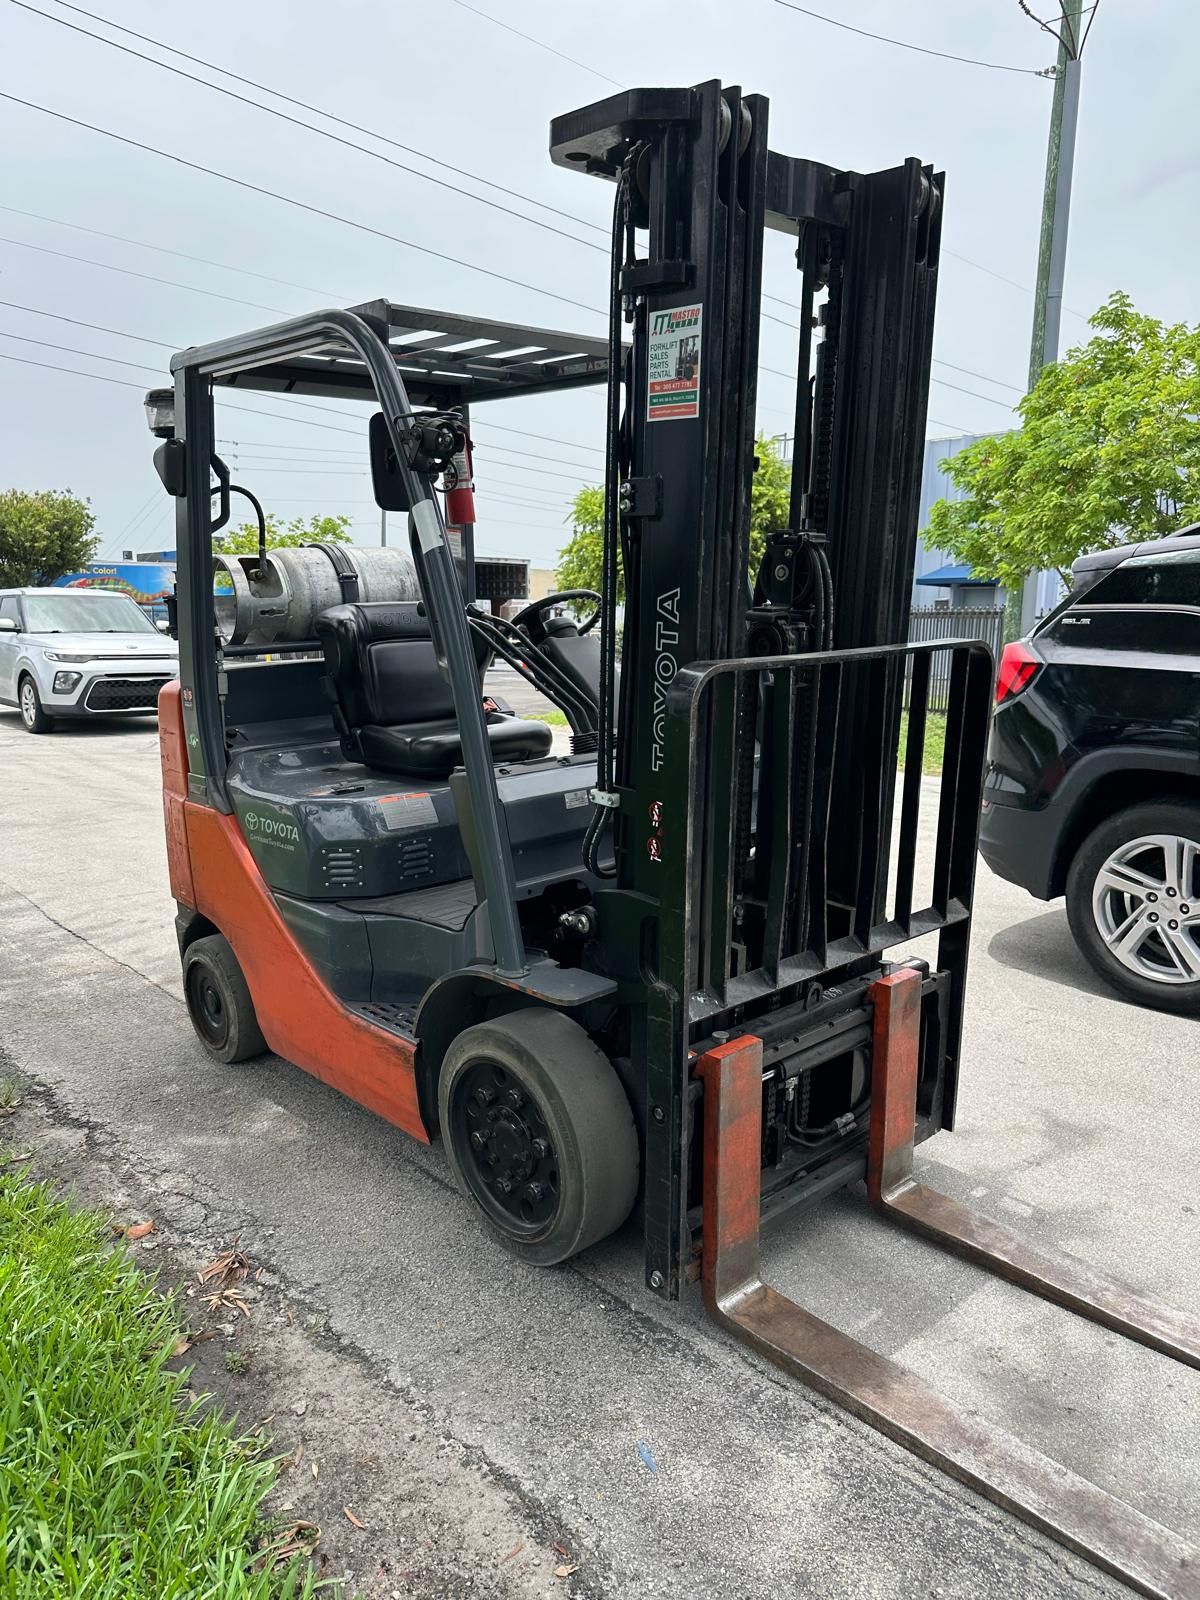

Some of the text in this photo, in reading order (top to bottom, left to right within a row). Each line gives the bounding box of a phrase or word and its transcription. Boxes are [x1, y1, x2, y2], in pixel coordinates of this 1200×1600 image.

[671, 308, 700, 321] MASTRO
[650, 341, 678, 351] FORKLIFT
[650, 352, 669, 361] SALES
[650, 361, 669, 370] PARTS
[650, 370, 672, 380] RENTAL
[92, 567, 117, 575] Color!
[259, 817, 300, 842] TOYOTA
